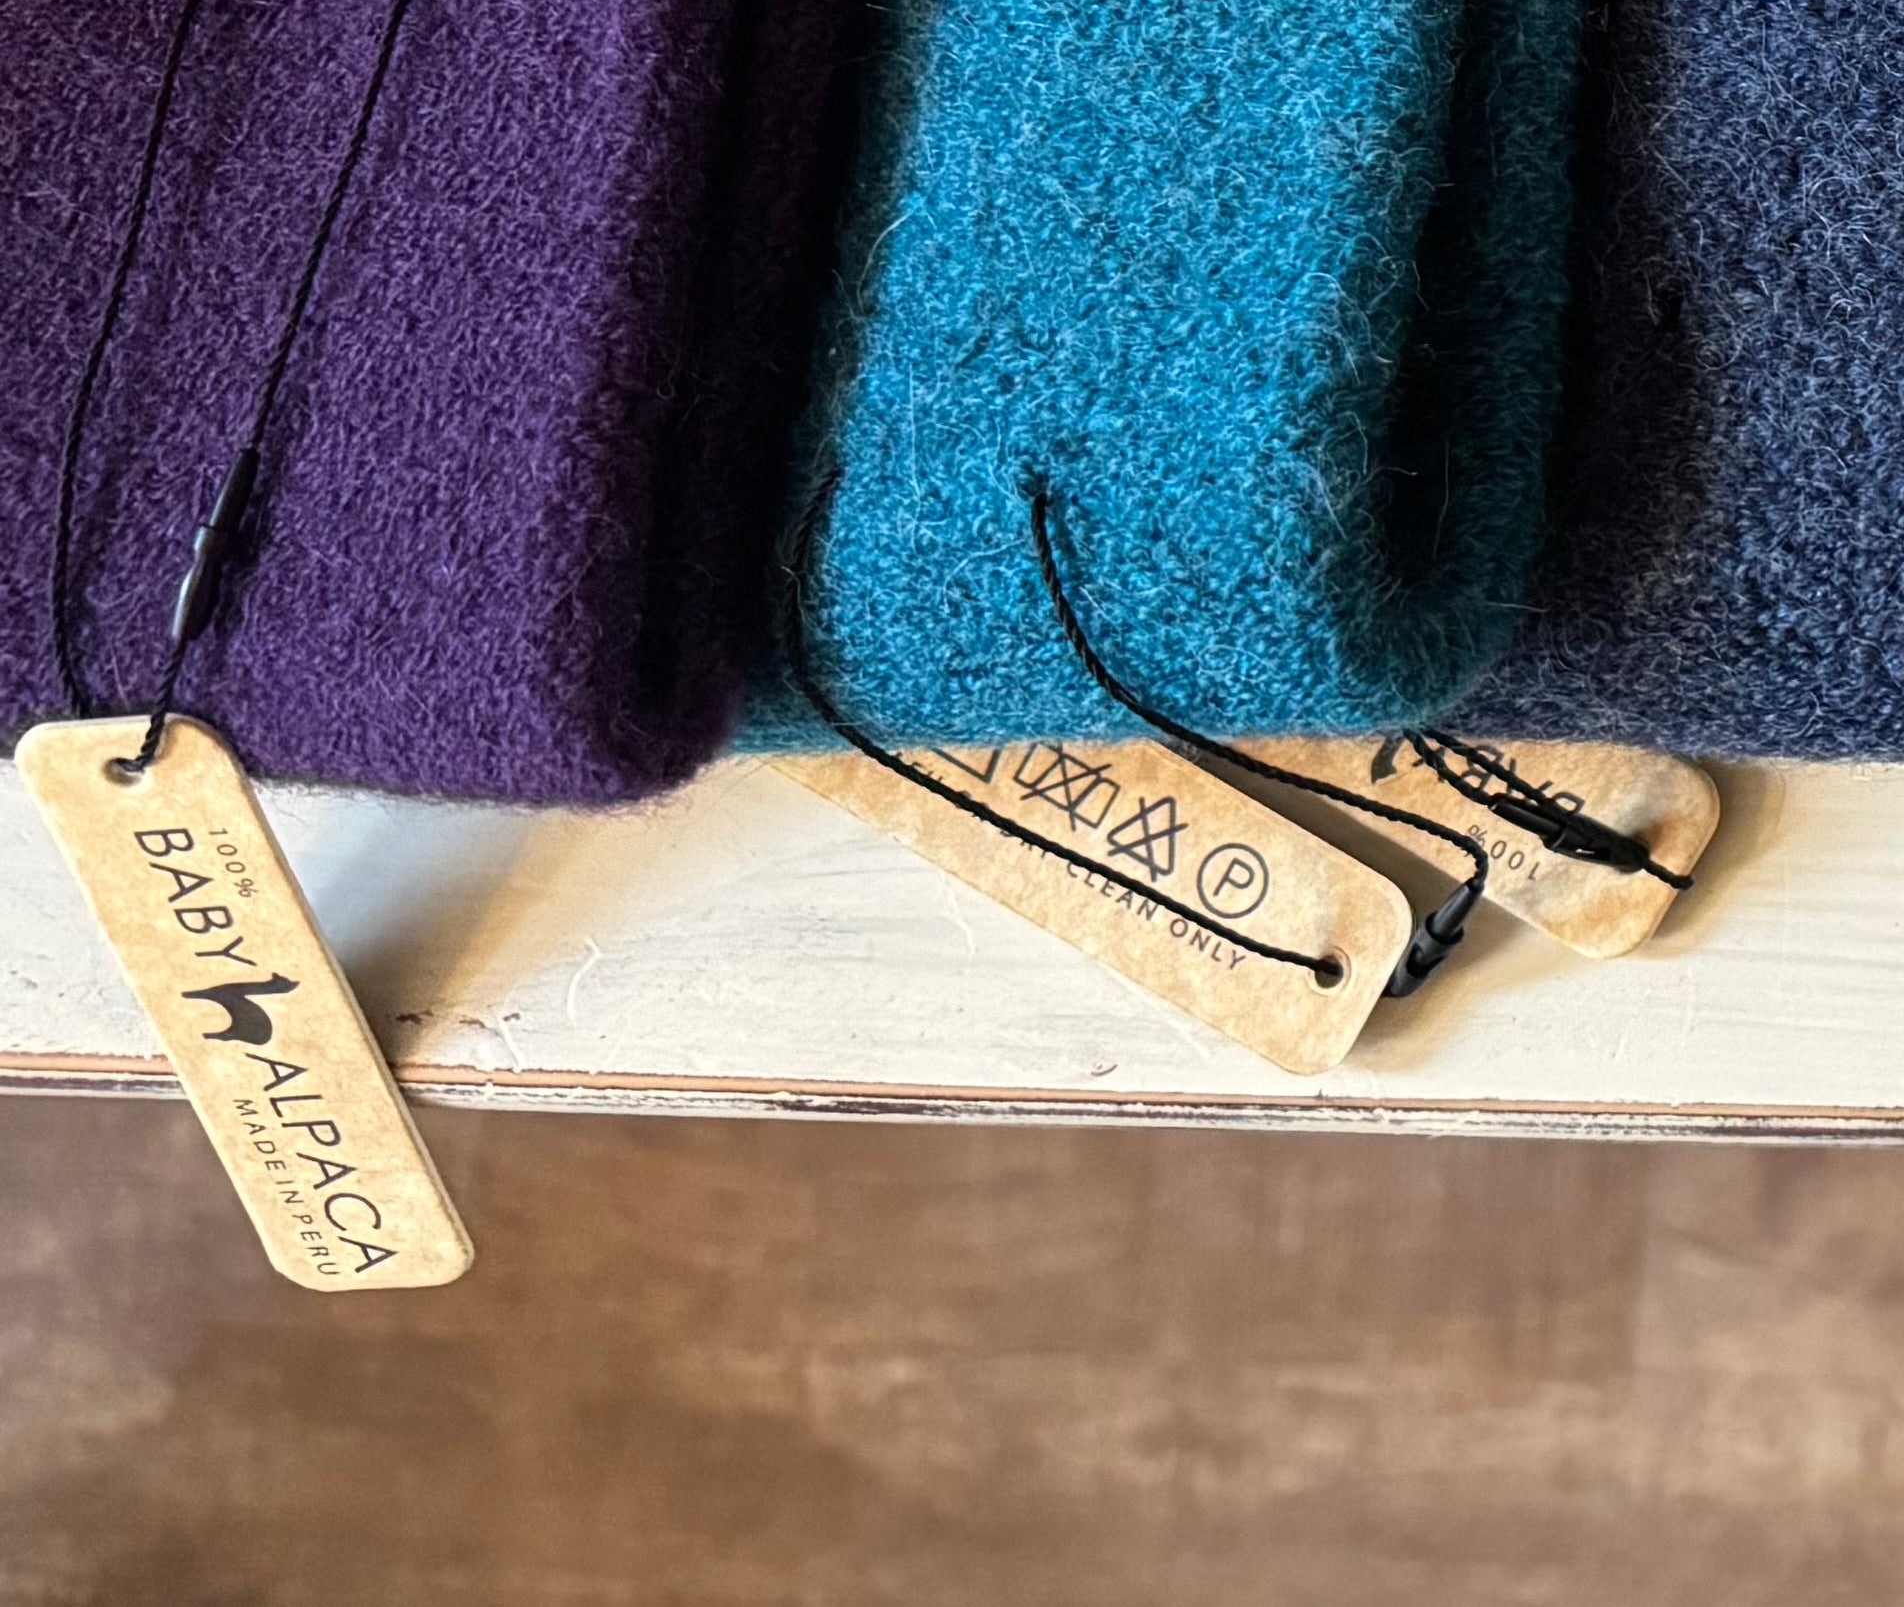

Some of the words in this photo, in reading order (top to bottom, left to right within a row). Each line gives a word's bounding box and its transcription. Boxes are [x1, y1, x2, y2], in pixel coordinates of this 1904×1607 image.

[208, 827, 260, 898] 100%
[1169, 917, 1247, 970] ONLY
[134, 827, 258, 967] BABY
[245, 1052, 399, 1274] ALPACA
[232, 1099, 287, 1173] MADE
[275, 1180, 305, 1205] IN
[291, 1214, 341, 1276] PERU
